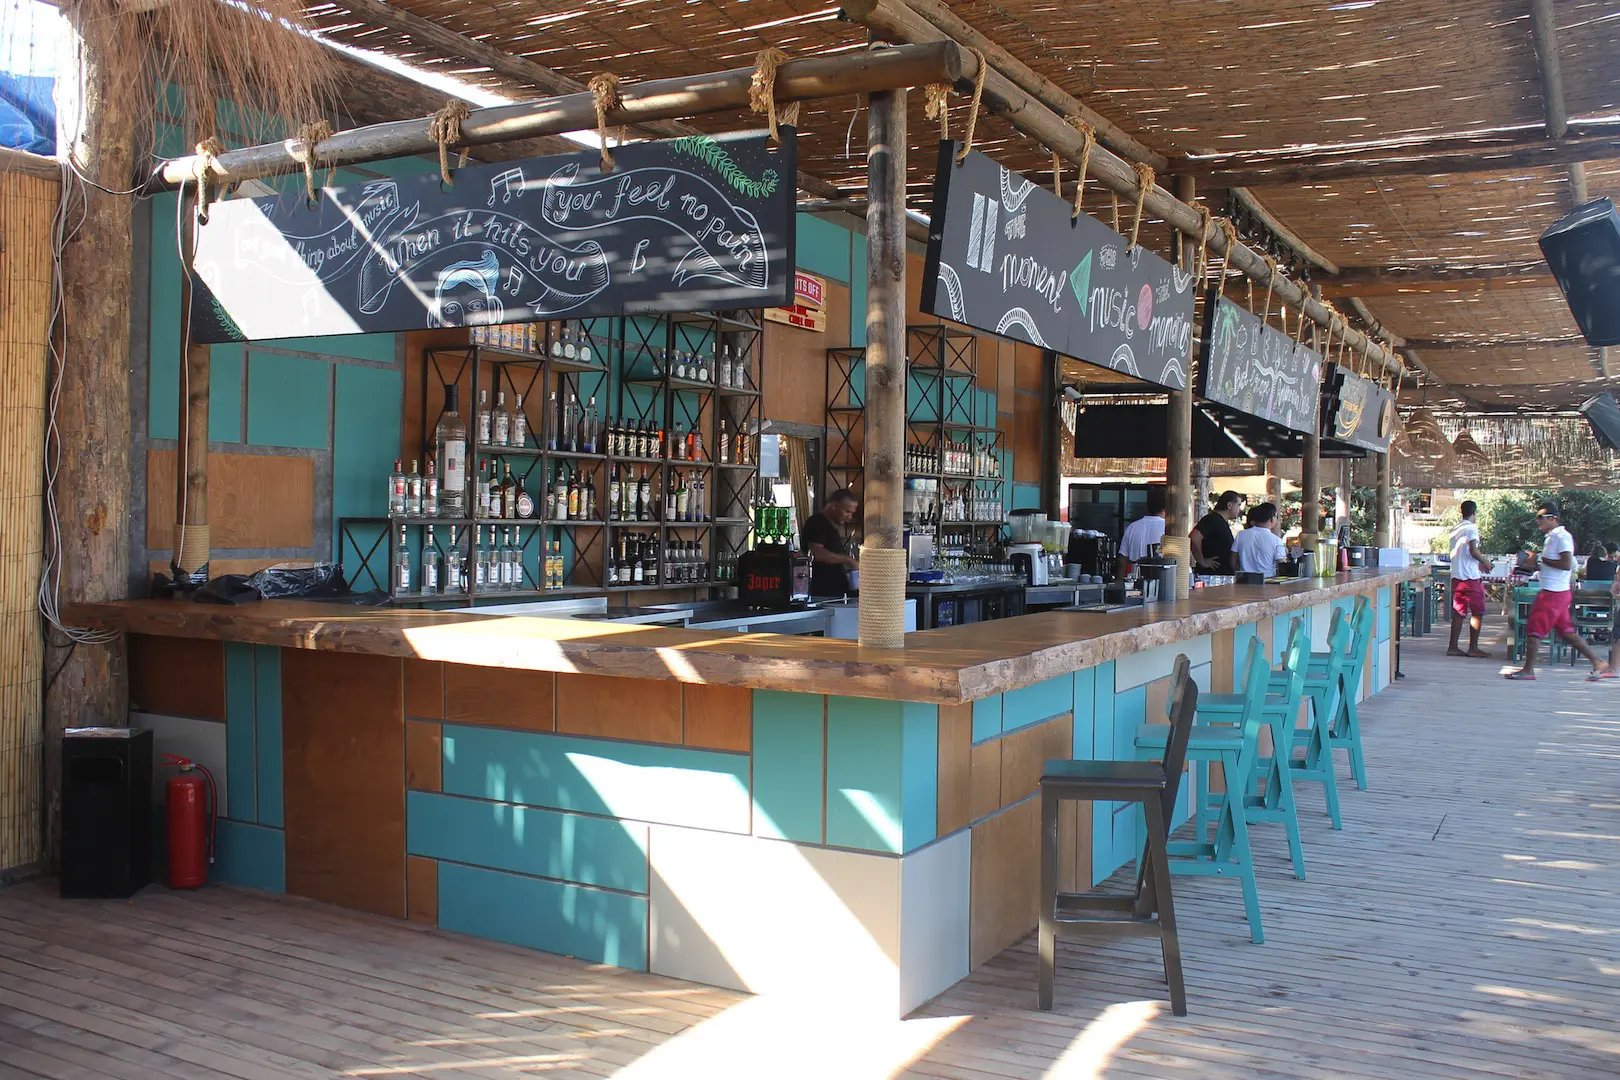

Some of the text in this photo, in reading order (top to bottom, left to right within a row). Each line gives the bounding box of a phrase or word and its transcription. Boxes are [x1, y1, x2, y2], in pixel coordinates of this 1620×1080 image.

[326, 231, 358, 262] about
[362, 193, 394, 226] music
[379, 212, 586, 281] When it hits you
[553, 174, 753, 272] you feel no pain
[808, 282, 820, 297] OFF
[1000, 253, 1066, 313] moment
[1089, 285, 1136, 339] music
[1148, 312, 1190, 357] memories
